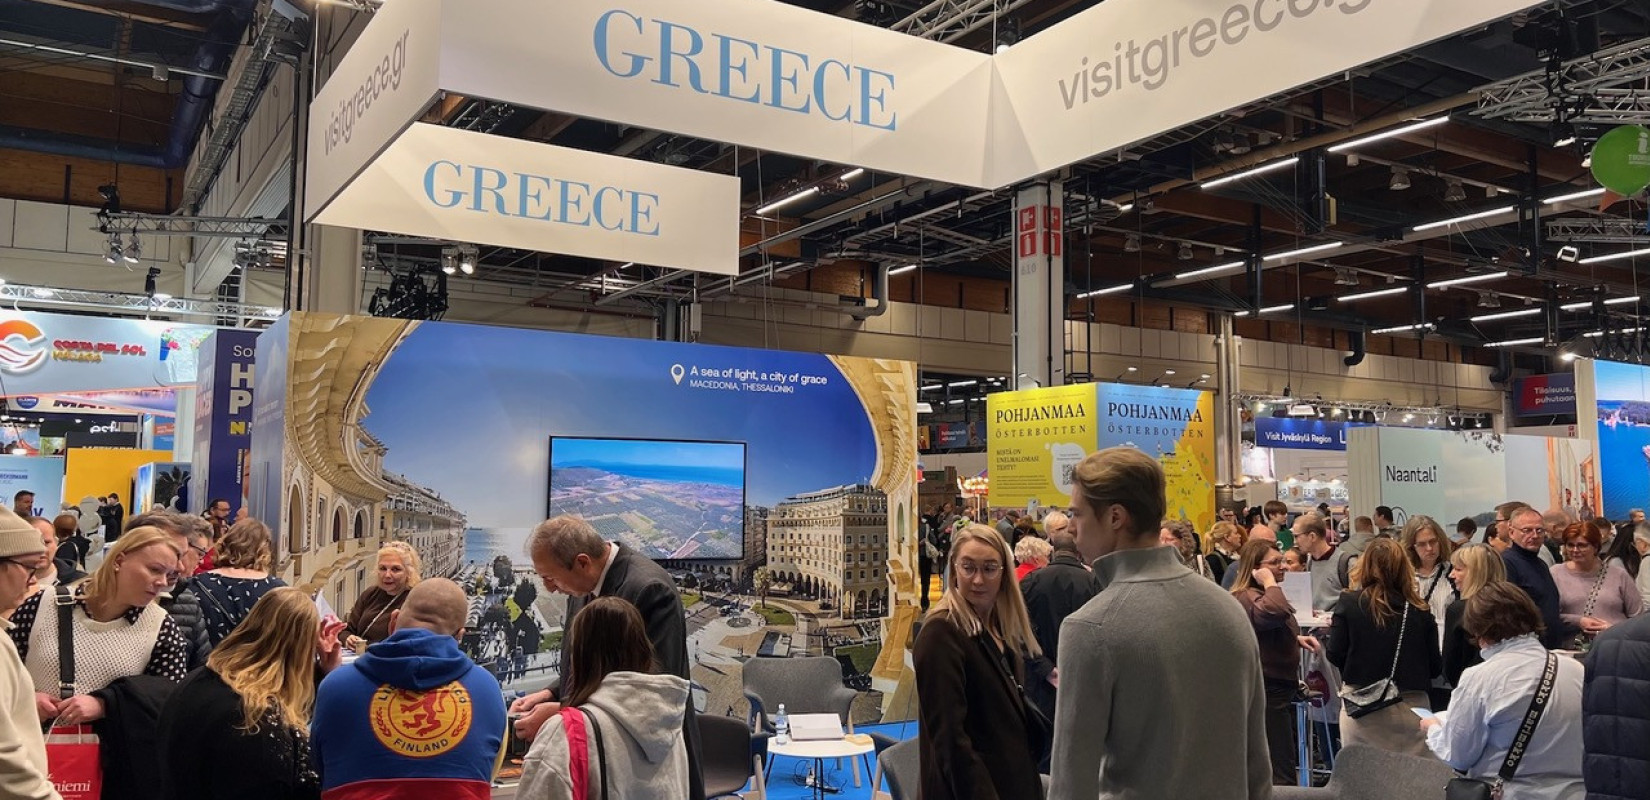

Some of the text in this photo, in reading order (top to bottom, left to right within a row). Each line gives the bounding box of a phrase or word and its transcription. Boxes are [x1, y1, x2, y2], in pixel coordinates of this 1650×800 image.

[592, 8, 897, 131] GREECE
[325, 28, 410, 156] visitgreece.gr
[423, 159, 660, 236] GREECE
[232, 344, 256, 357] So
[690, 366, 828, 386] A sea of light, a city of grace
[690, 380, 794, 394] MACEDONIA, THESSALONIKI
[995, 402, 1086, 424] POHJANMAA
[1107, 402, 1203, 423] POHJANMAA
[995, 424, 1087, 438] ÖSTERBOTTEN
[1107, 423, 1204, 439] ÖSTERBOTTEN
[1265, 432, 1281, 441] Visit
[1282, 432, 1310, 443] Jyväskylä
[1311, 434, 1332, 444] Region
[1386, 465, 1437, 483] Naantali
[393, 738, 449, 753] FINLAND
